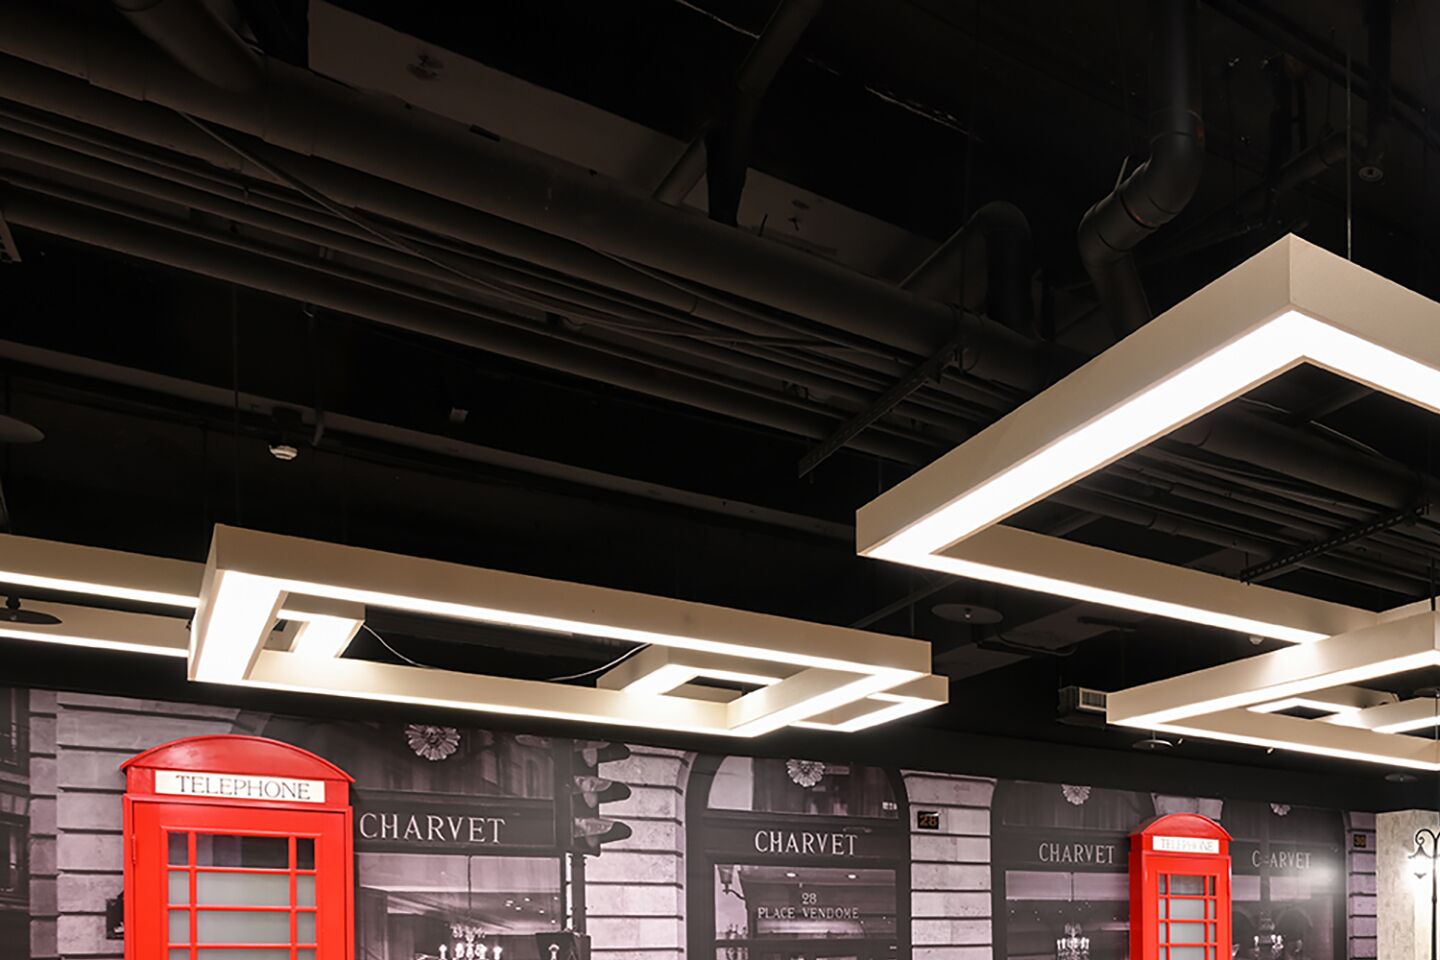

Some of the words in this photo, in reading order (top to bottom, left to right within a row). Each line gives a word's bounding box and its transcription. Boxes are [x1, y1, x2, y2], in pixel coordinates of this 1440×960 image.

[175, 774, 311, 800] TELEPHONE
[359, 812, 506, 844] CHARVET
[919, 814, 939, 827] 28
[754, 830, 859, 856] CHARVET
[1039, 842, 1115, 864] CHARVET
[801, 892, 817, 905] 28
[757, 907, 795, 920] PLACE
[802, 907, 859, 920] VENDOME
